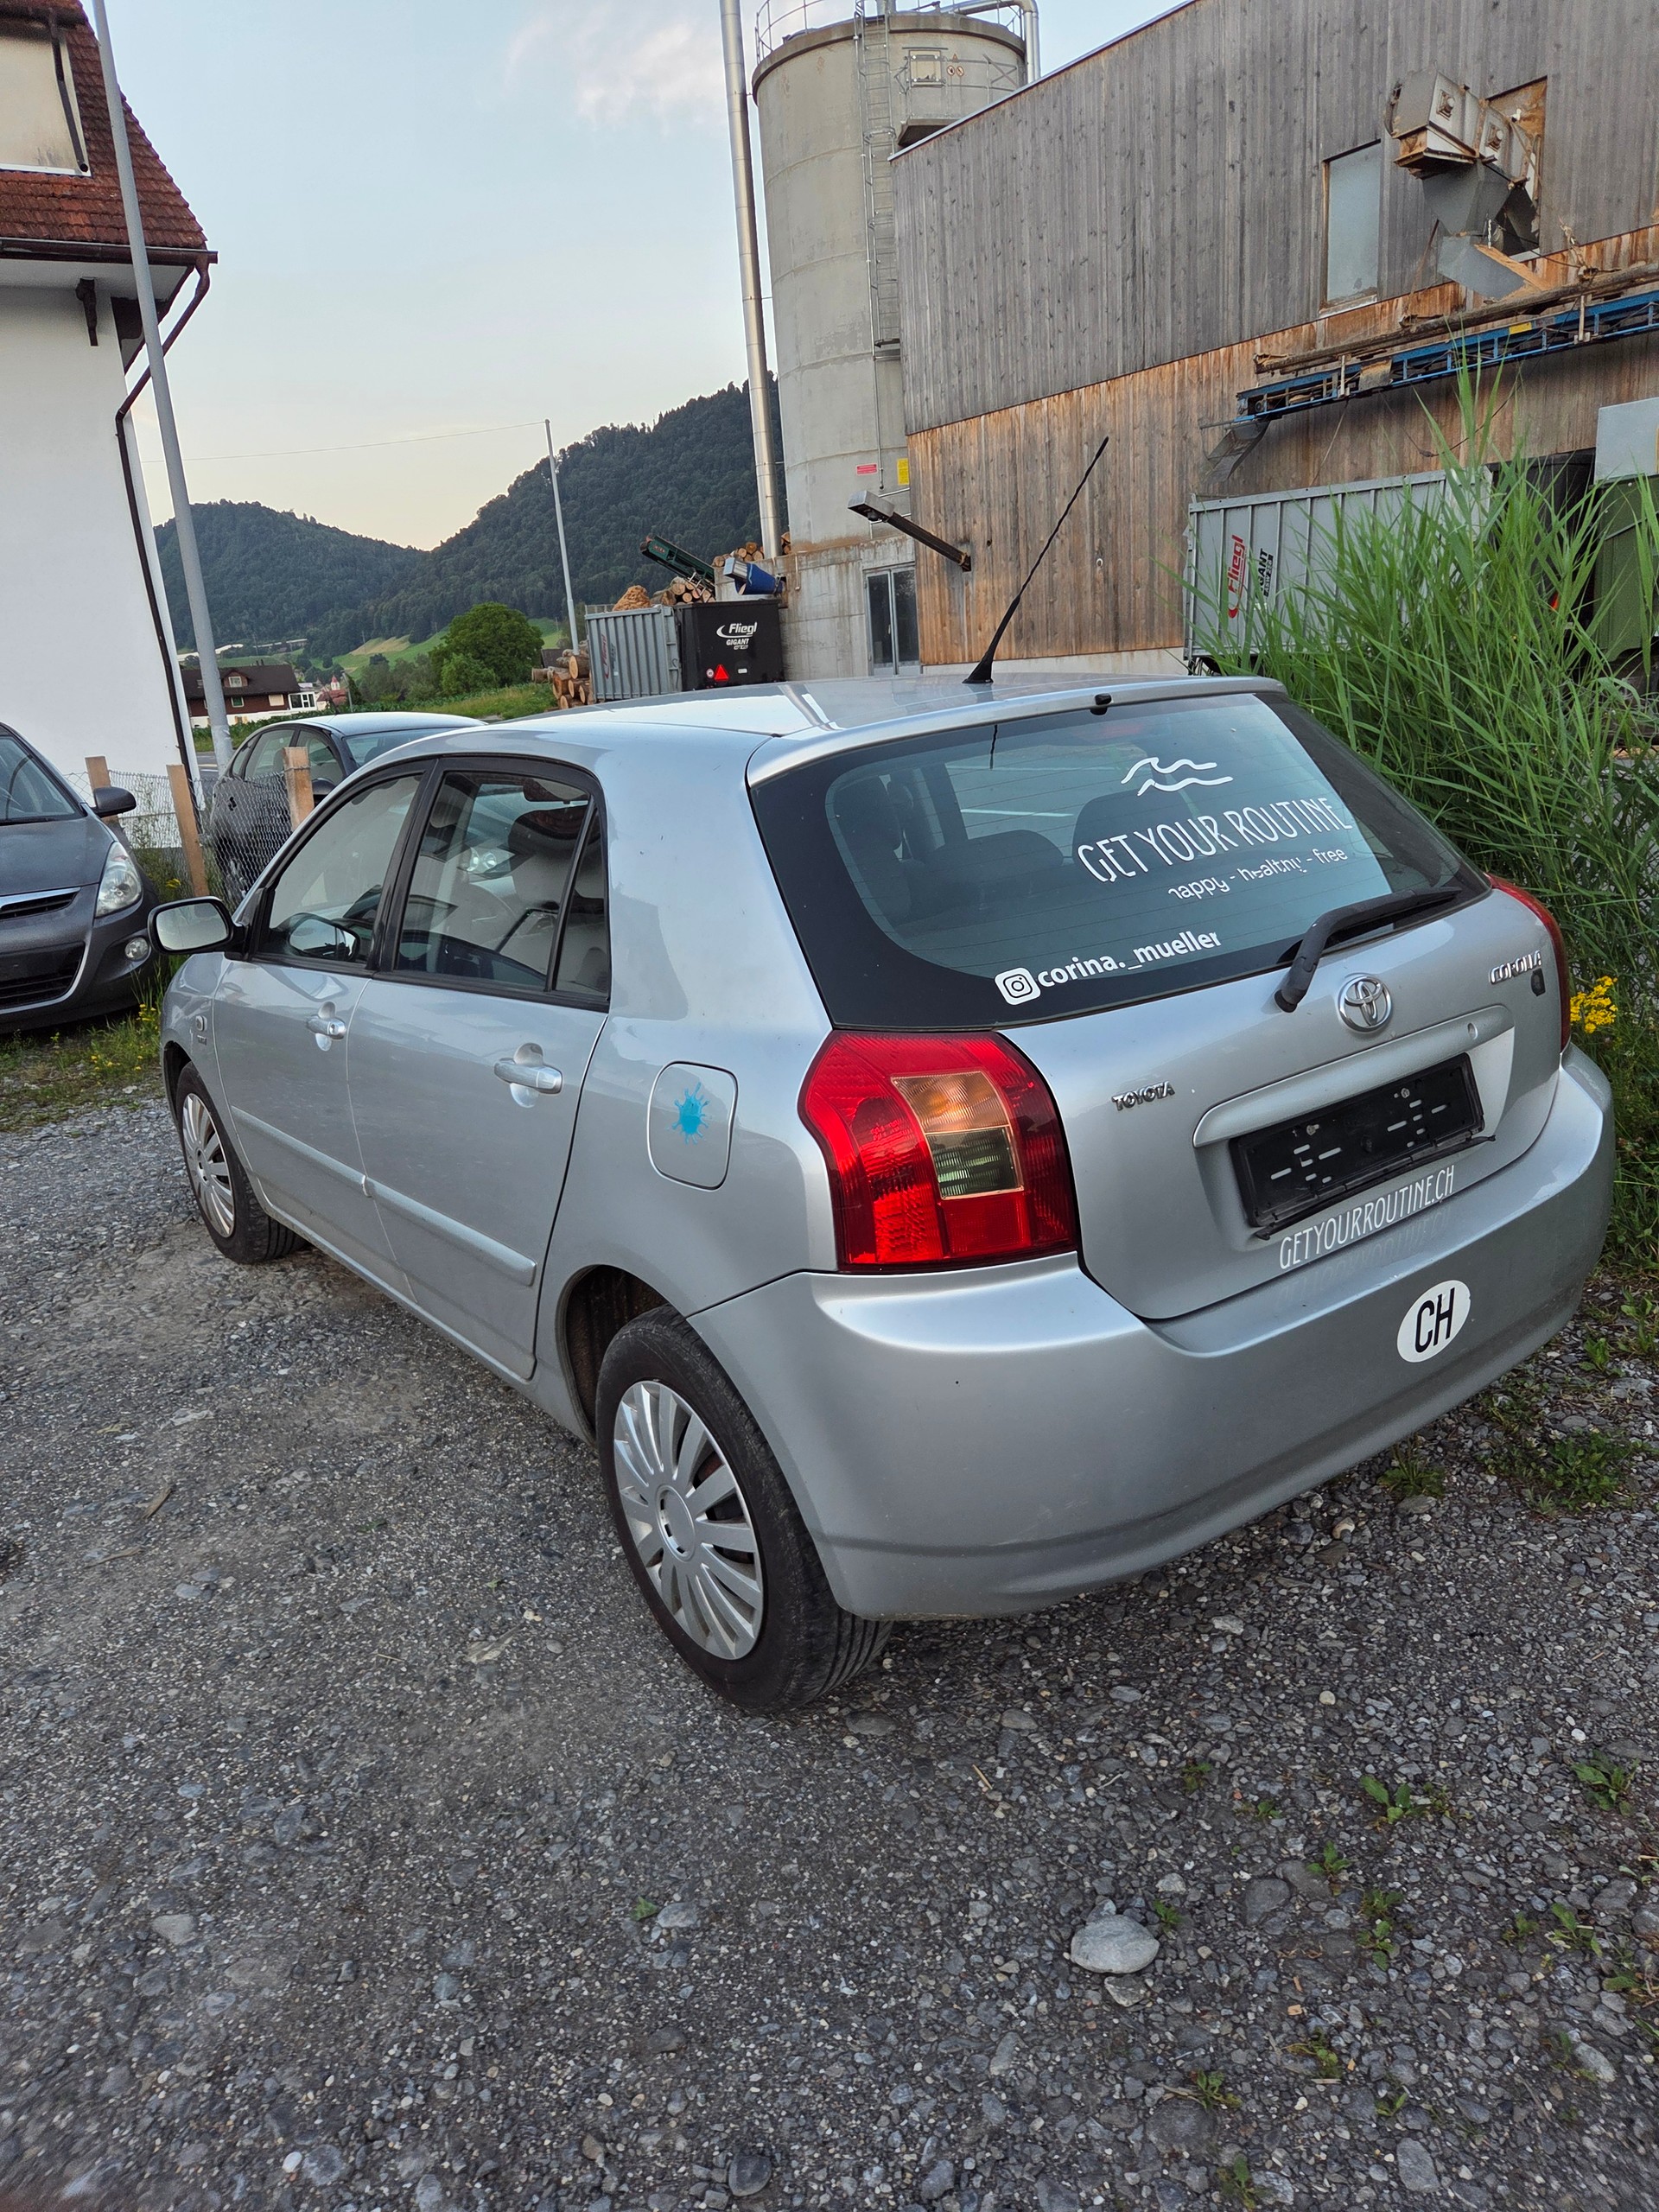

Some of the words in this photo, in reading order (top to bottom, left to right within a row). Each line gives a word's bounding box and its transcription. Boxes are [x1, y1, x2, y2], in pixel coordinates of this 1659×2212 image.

[1227, 534, 1245, 594] Fliegl
[726, 638, 750, 646] GIGANT
[728, 621, 758, 635] Fliegl
[1077, 834, 1148, 883] GET
[1133, 815, 1239, 867] YOUR
[1223, 797, 1353, 847] ROUTINE
[1312, 849, 1348, 864] free
[1038, 931, 1222, 988] corina._mueller
[1490, 950, 1542, 985] COROLLA
[1111, 1080, 1175, 1111] TOYOTA
[1279, 1164, 1455, 1270] GETYOURROUTINE.CH
[1414, 1287, 1455, 1353] CH
